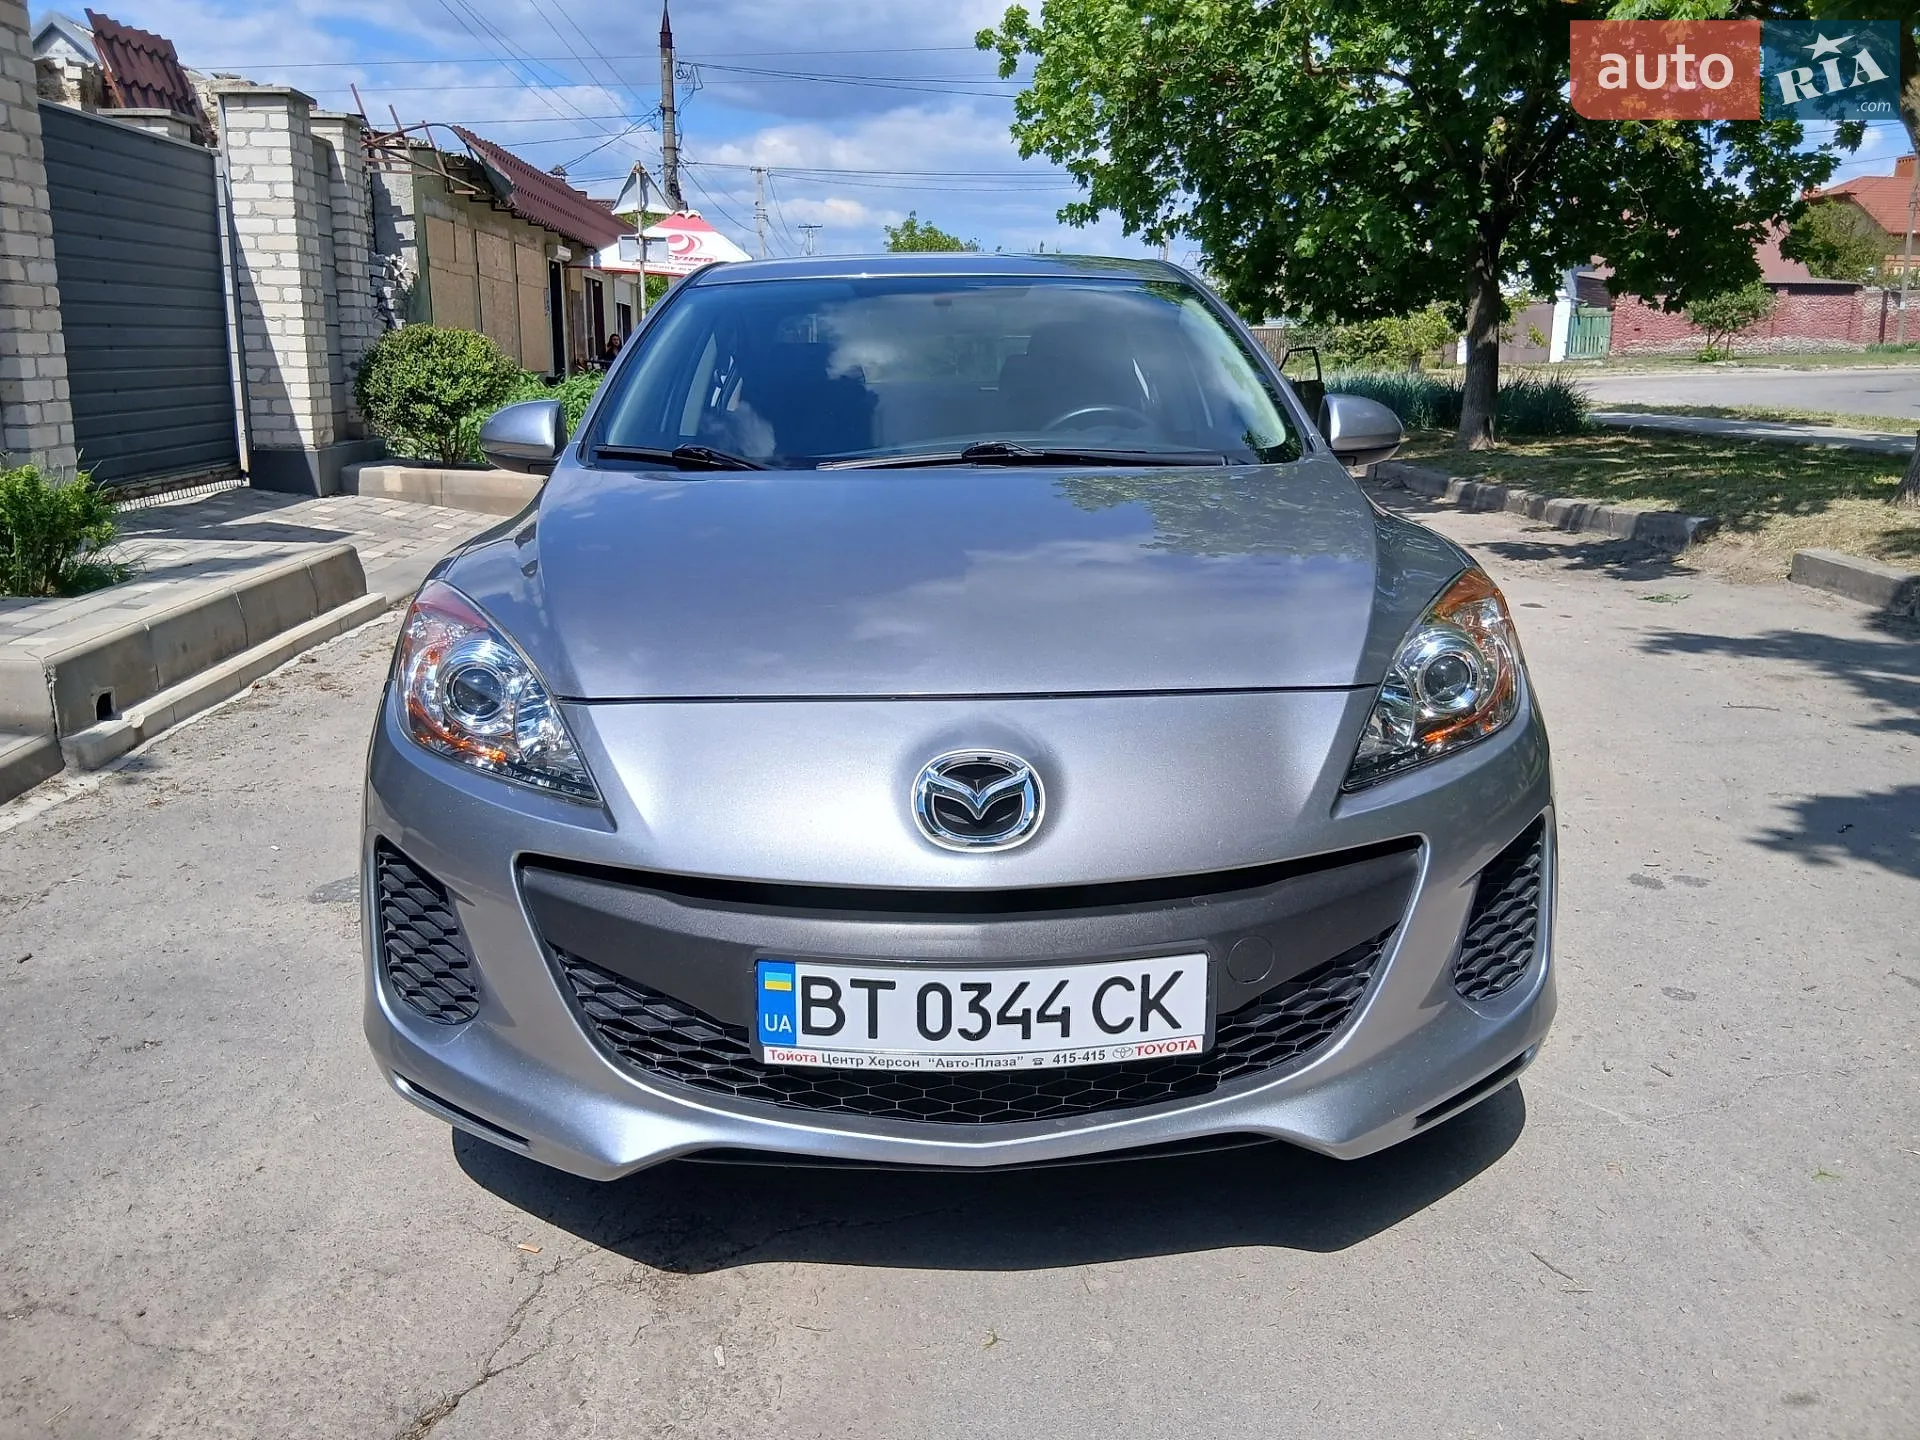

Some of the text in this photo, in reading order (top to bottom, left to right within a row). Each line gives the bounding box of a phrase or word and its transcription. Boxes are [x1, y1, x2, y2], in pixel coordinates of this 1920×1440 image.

[800, 970, 1184, 1041] BT 0344 CK
[764, 1013, 792, 1033] UA
[769, 1049, 817, 1063] Тойота
[822, 1053, 864, 1068] Центр
[868, 1055, 920, 1068] Херсон
[1052, 1049, 1106, 1065] 415-415
[1135, 1039, 1198, 1057] TOYOTA
